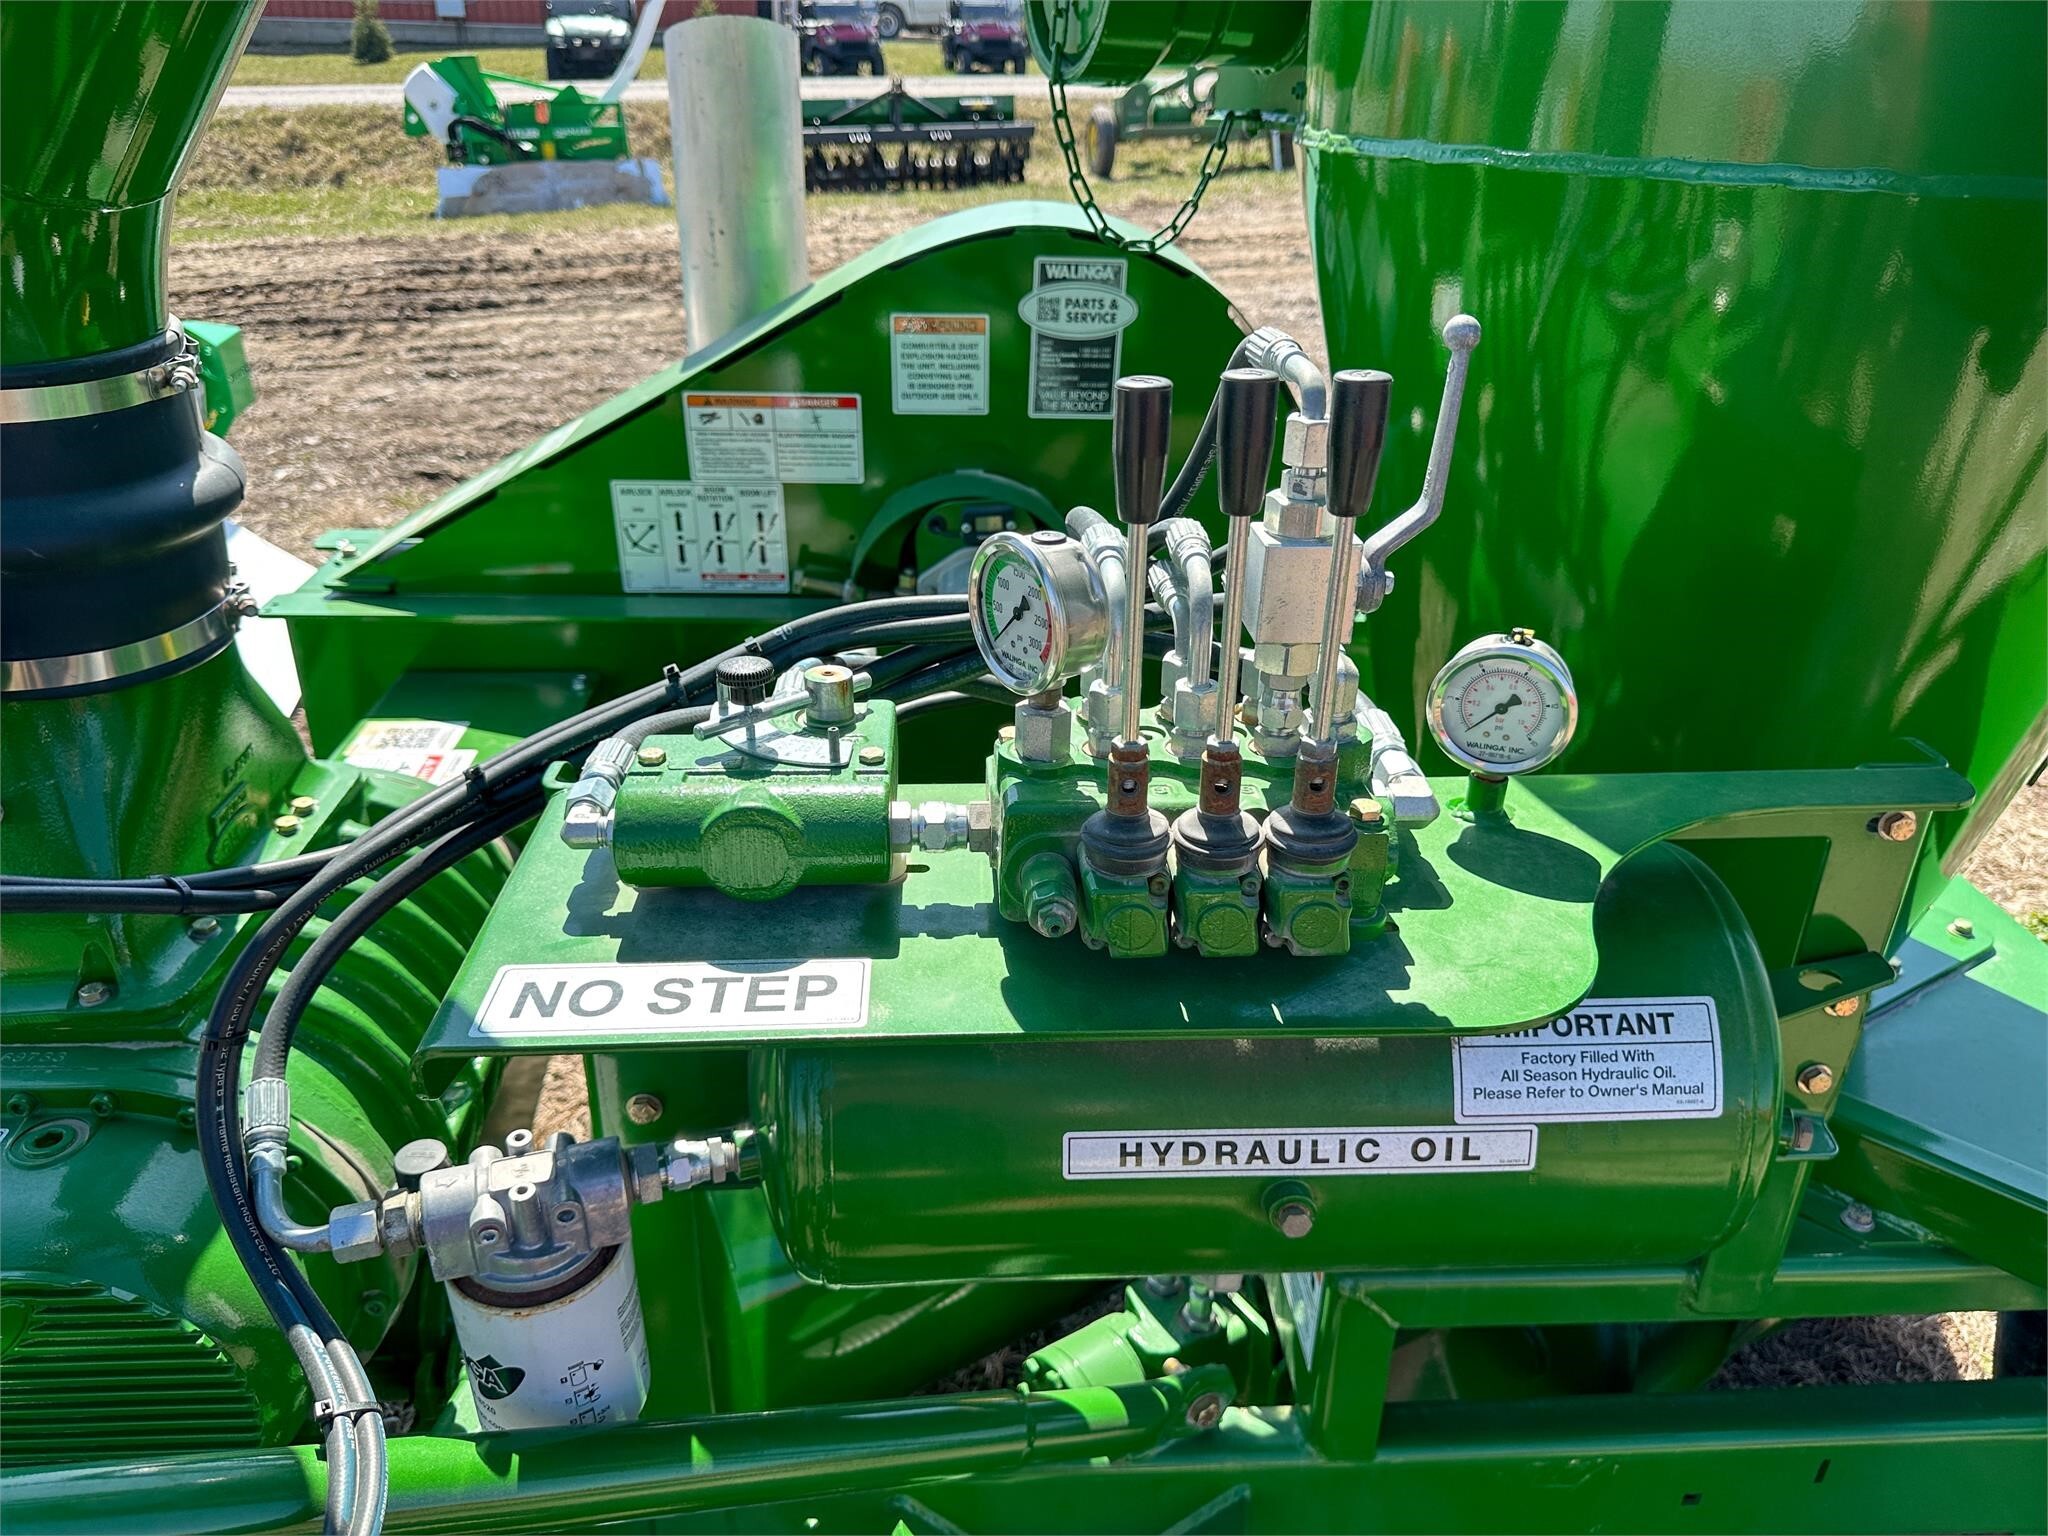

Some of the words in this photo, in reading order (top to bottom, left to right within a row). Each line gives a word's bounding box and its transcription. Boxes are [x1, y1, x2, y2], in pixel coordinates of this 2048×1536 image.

[1045, 264, 1115, 280] WALINGA
[1065, 298, 1105, 310] PARTS
[1109, 299, 1119, 310] &
[1065, 311, 1117, 324] SERVICE
[1068, 390, 1109, 401] BEYOND
[1042, 401, 1058, 410] THE
[1061, 401, 1105, 411] PRODUCT
[997, 576, 1010, 591] 1000
[1027, 585, 1042, 600] 2000
[993, 600, 1003, 613] 500
[1034, 614, 1048, 630] 2500
[1028, 635, 1042, 651] 3000
[1001, 649, 1027, 669] WALINGA
[1466, 740, 1506, 752] WALINGA
[509, 978, 625, 1020] NO
[647, 974, 839, 1016] STEP
[1521, 1051, 1576, 1067] Factory
[1580, 1050, 1618, 1064] Filled
[1621, 1049, 1655, 1063] With
[1501, 1069, 1519, 1082] All
[1523, 1068, 1577, 1082] Season
[1582, 1066, 1649, 1083] Hydraulic
[1653, 1065, 1676, 1079] Oil.
[1473, 1086, 1522, 1100] Please
[1526, 1085, 1565, 1099] Refer
[1569, 1086, 1583, 1098] to
[1588, 1084, 1648, 1098] Owner's
[1651, 1082, 1704, 1096] Manual
[1118, 1138, 1381, 1168] HYDRAULIC
[1410, 1136, 1482, 1162] OIL
[223, 1153, 245, 1206] Resistant
[240, 1205, 258, 1237] MSHA
